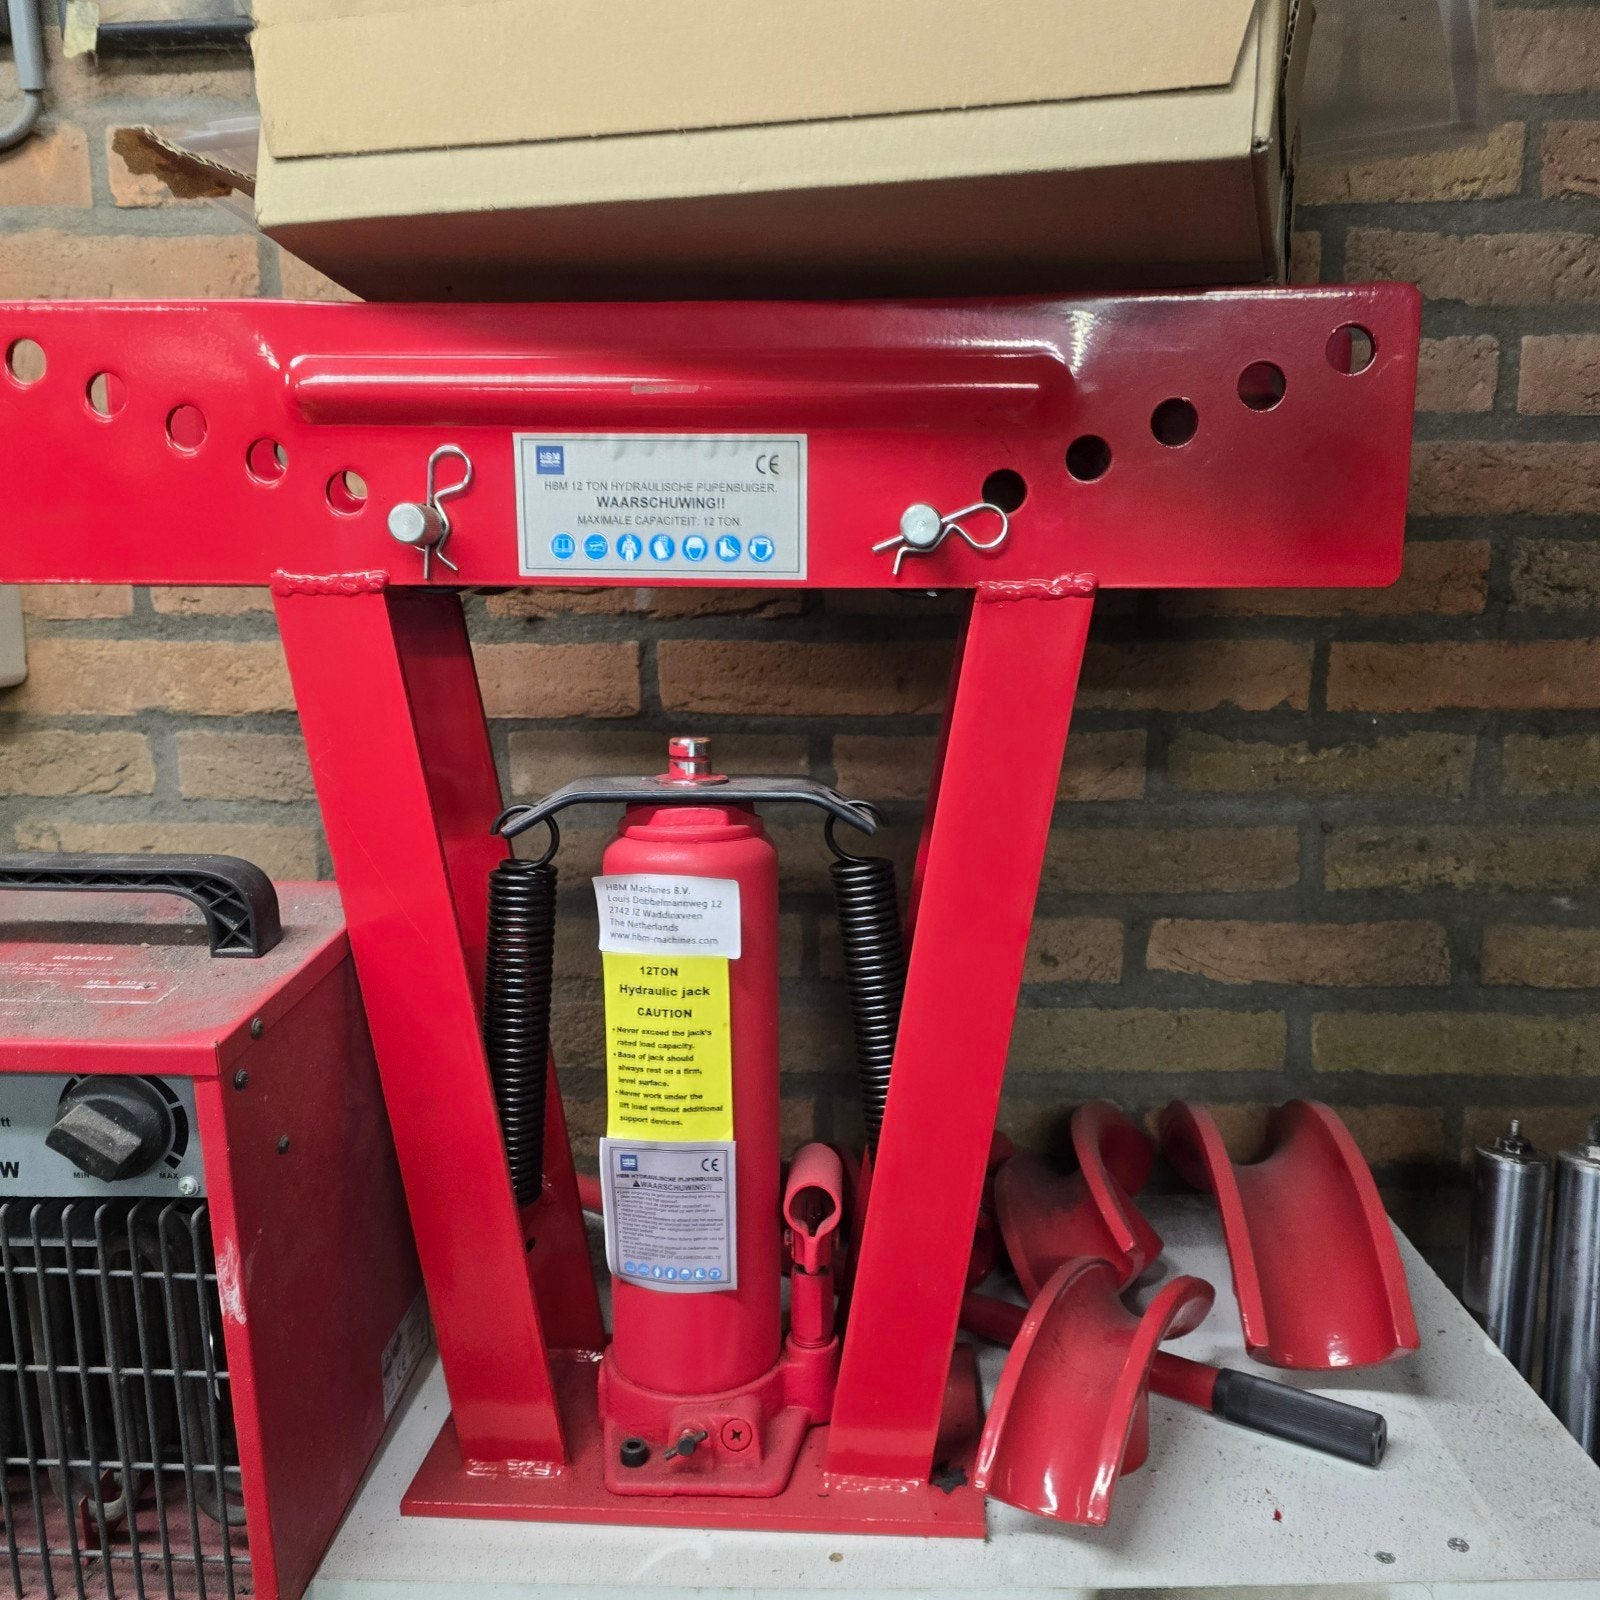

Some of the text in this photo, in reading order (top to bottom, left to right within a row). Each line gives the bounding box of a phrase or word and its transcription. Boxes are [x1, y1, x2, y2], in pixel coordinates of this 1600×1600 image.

[755, 454, 780, 475] CE
[545, 481, 568, 491] HBM
[572, 481, 582, 491] 12
[586, 482, 607, 491] TON
[611, 482, 693, 491] HYDRAULISCHE
[597, 497, 725, 509] WAARSCHUWING!!
[578, 516, 632, 525] MAXIMALE
[703, 517, 715, 525] 12
[630, 884, 671, 894] Machines
[608, 895, 630, 903] Louis
[609, 907, 629, 915] 2742
[610, 918, 679, 931] The Netherlands
[610, 932, 718, 944] www.hbm-machines.com
[640, 967, 678, 976] 12TON
[619, 984, 710, 998] Hydraulic jack
[637, 1008, 692, 1018] CAUTION
[641, 1028, 669, 1036] exceed
[648, 1054, 664, 1062] jack
[618, 1065, 644, 1073] always
[644, 1091, 662, 1099] work
[665, 1092, 688, 1100] under
[632, 1102, 648, 1110] load
[650, 1104, 679, 1112] without
[620, 1115, 648, 1124] support
[701, 1158, 719, 1171] CE
